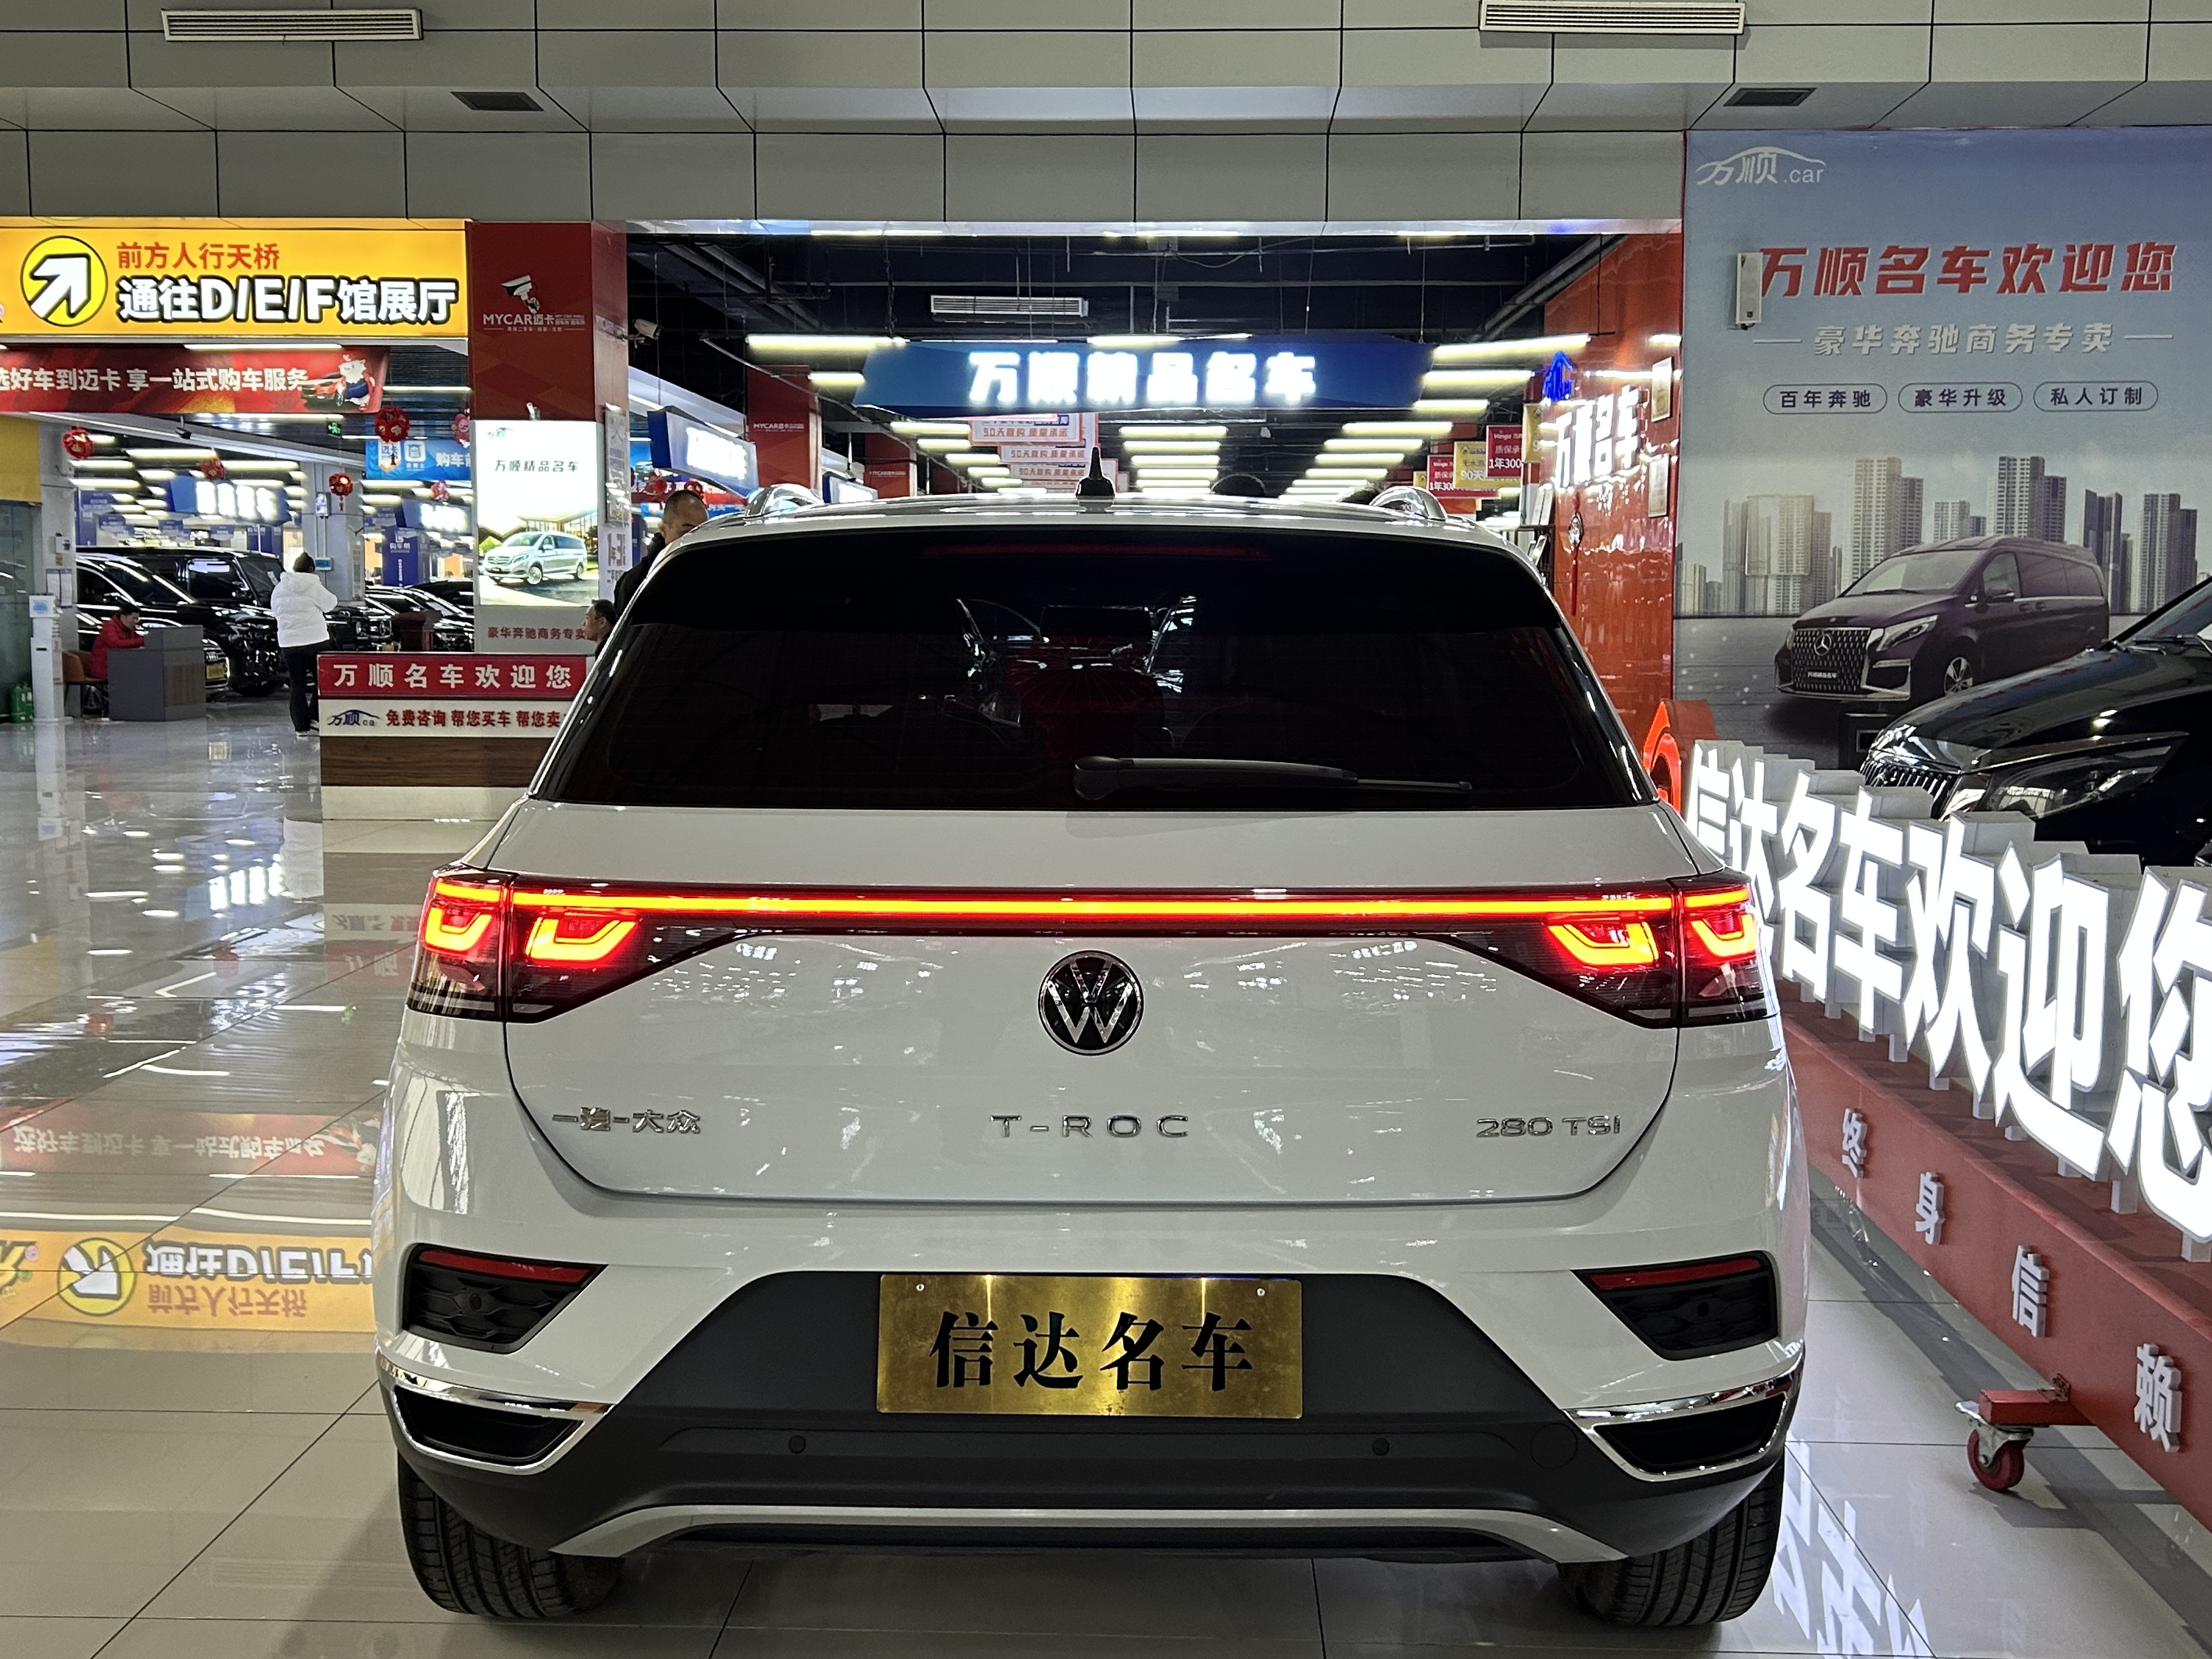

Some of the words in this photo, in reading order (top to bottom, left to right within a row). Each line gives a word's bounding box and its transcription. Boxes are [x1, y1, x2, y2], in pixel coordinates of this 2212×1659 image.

[1696, 146, 1778, 185] 万顺
[117, 242, 279, 270] 前方人行天桥
[1760, 241, 2177, 297] 万顺名车欢迎您
[117, 276, 458, 323] 通往D/E/F馆展厅
[1814, 323, 2114, 355] 豪华奔驰商务专卖
[1780, 389, 1871, 409] 百年奔驰
[1914, 388, 2007, 408] 豪华升级
[2050, 386, 2142, 406] 私人订制
[333, 663, 572, 689] 万顺名车欢迎您
[386, 709, 446, 727] 免费咨询
[451, 709, 511, 728] 帮您买车
[516, 710, 566, 728] 帮您卖
[990, 1114, 1189, 1138] T-ROC
[1476, 1116, 1553, 1138] 280
[1561, 1115, 1622, 1136] TSI
[929, 1311, 1254, 1392] 信达名车
